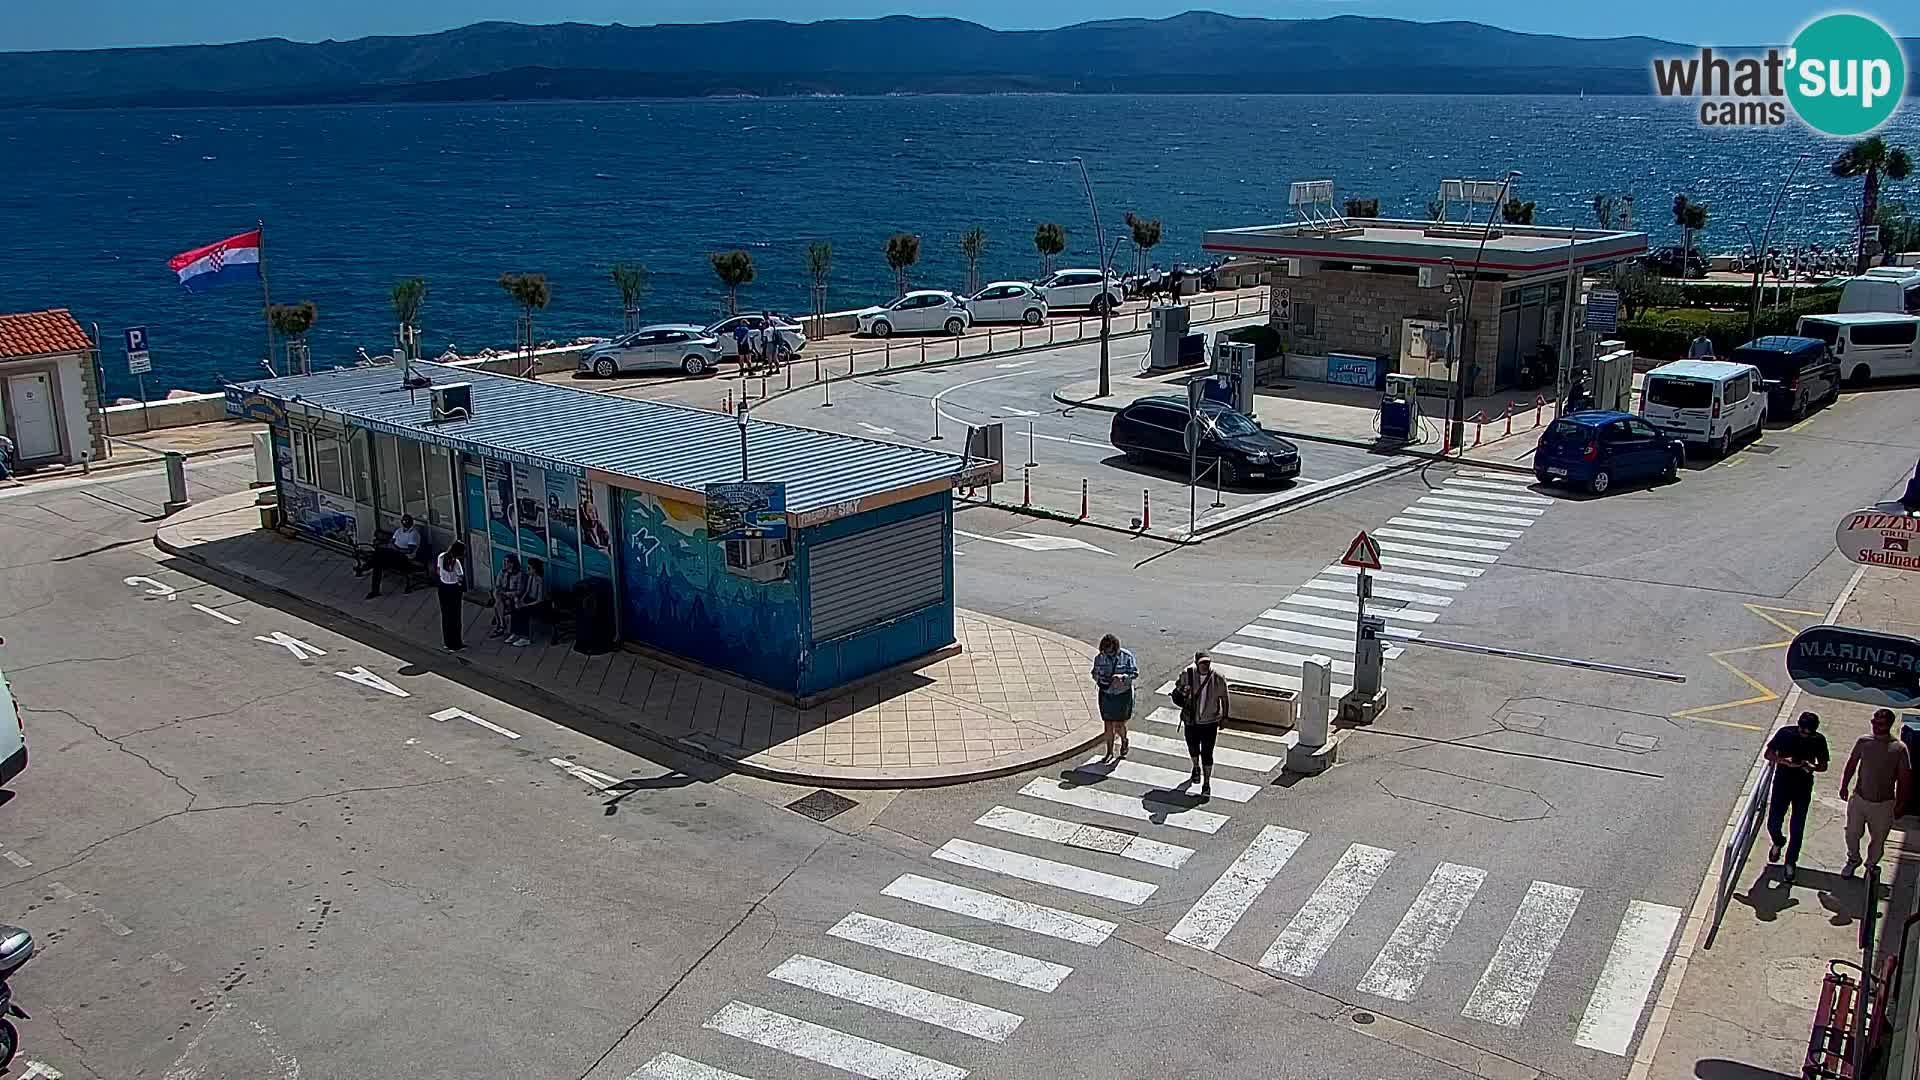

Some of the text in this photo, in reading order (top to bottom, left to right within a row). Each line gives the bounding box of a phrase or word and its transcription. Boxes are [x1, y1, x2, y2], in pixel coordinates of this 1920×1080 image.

[129, 330, 142, 348] P
[436, 436, 467, 450] POSTAJA
[478, 446, 582, 476] BUS STATION TICKET OFFICE
[1828, 661, 1896, 679] caffe bar
